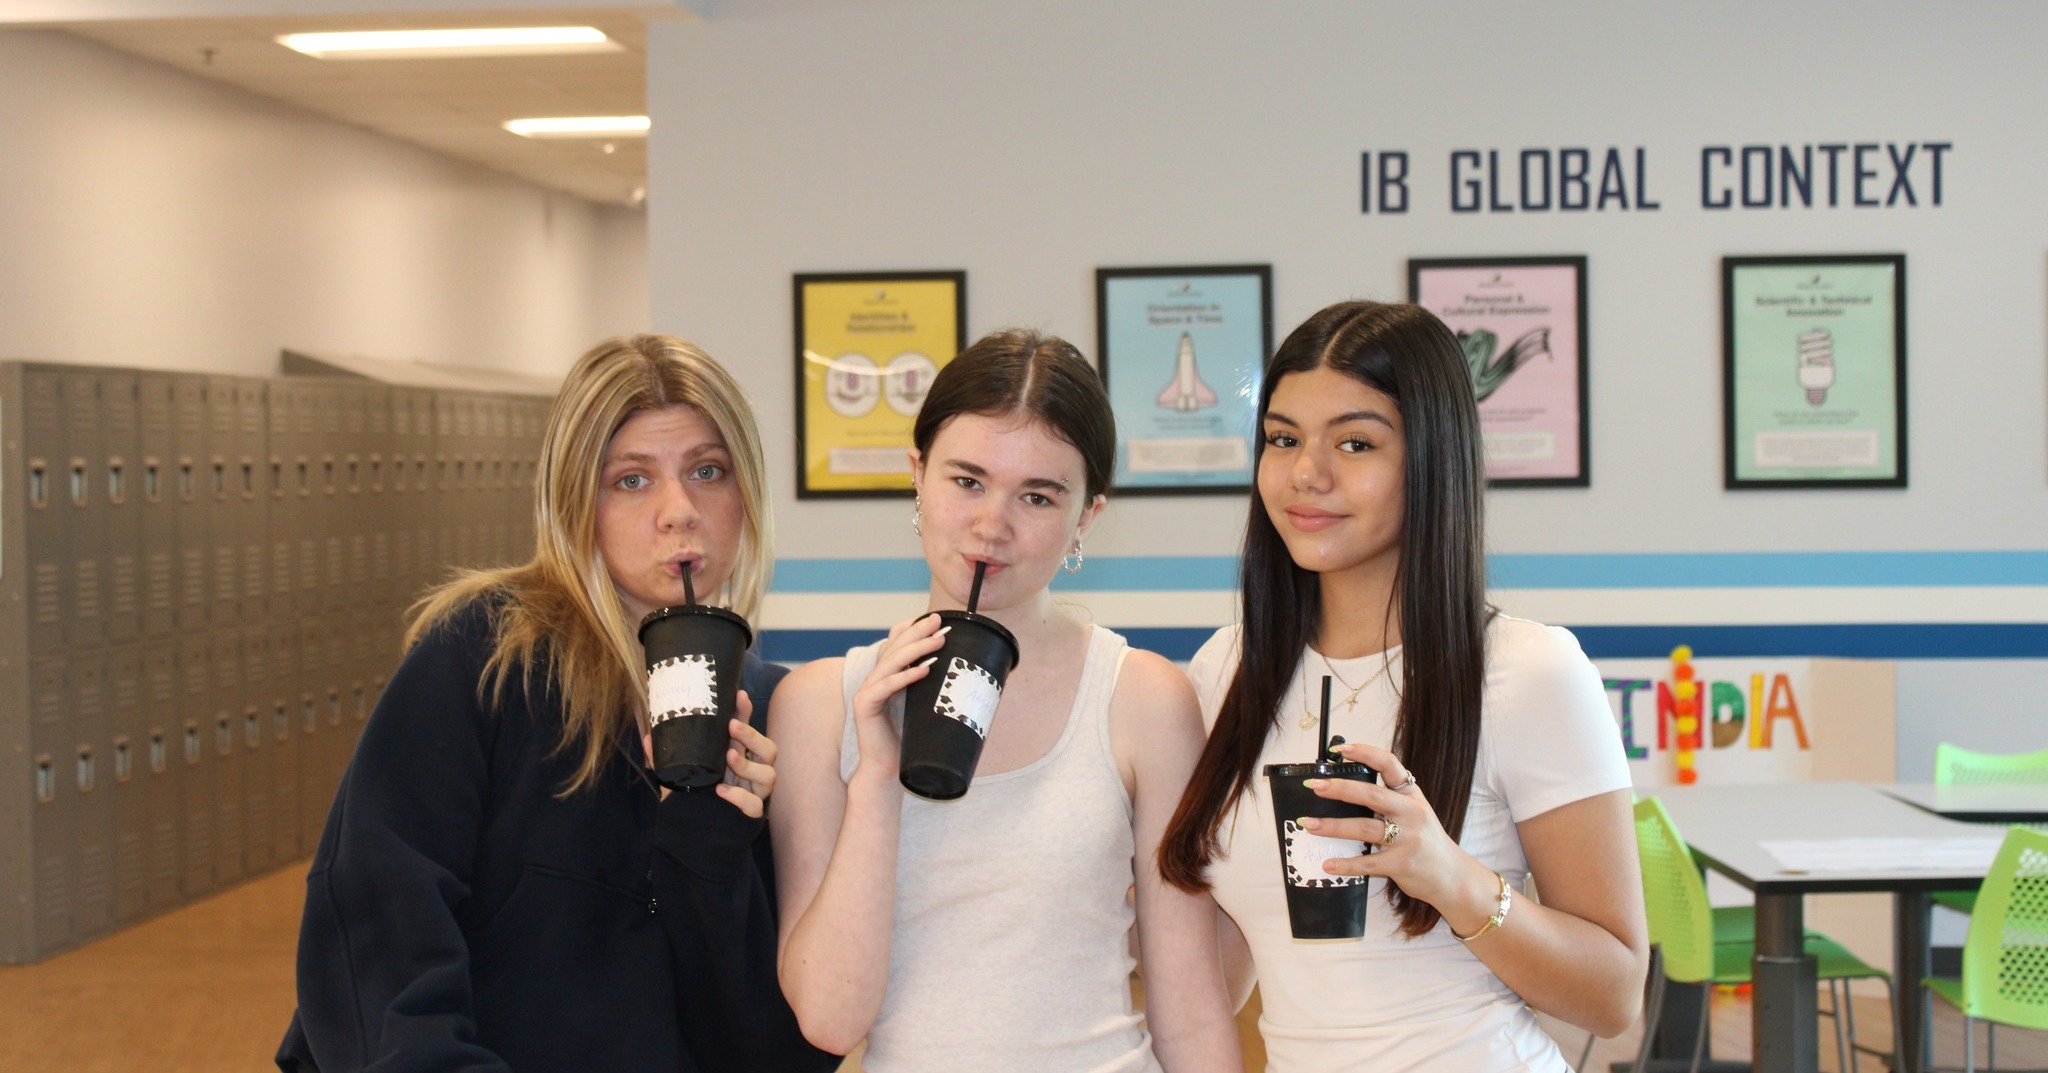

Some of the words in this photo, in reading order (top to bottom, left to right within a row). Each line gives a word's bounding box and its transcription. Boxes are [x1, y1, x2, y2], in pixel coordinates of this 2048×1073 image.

[1361, 151, 1409, 214] IB
[1450, 147, 1660, 213] GLOBAL
[1701, 142, 1953, 210] CONTEXT
[1464, 294, 1512, 304] Personal
[1756, 295, 1804, 305] Scientific
[1443, 306, 1485, 316] Cultural
[1489, 305, 1552, 317] Expression
[1786, 308, 1844, 317] Innovation
[1602, 673, 1811, 760] INDIA
